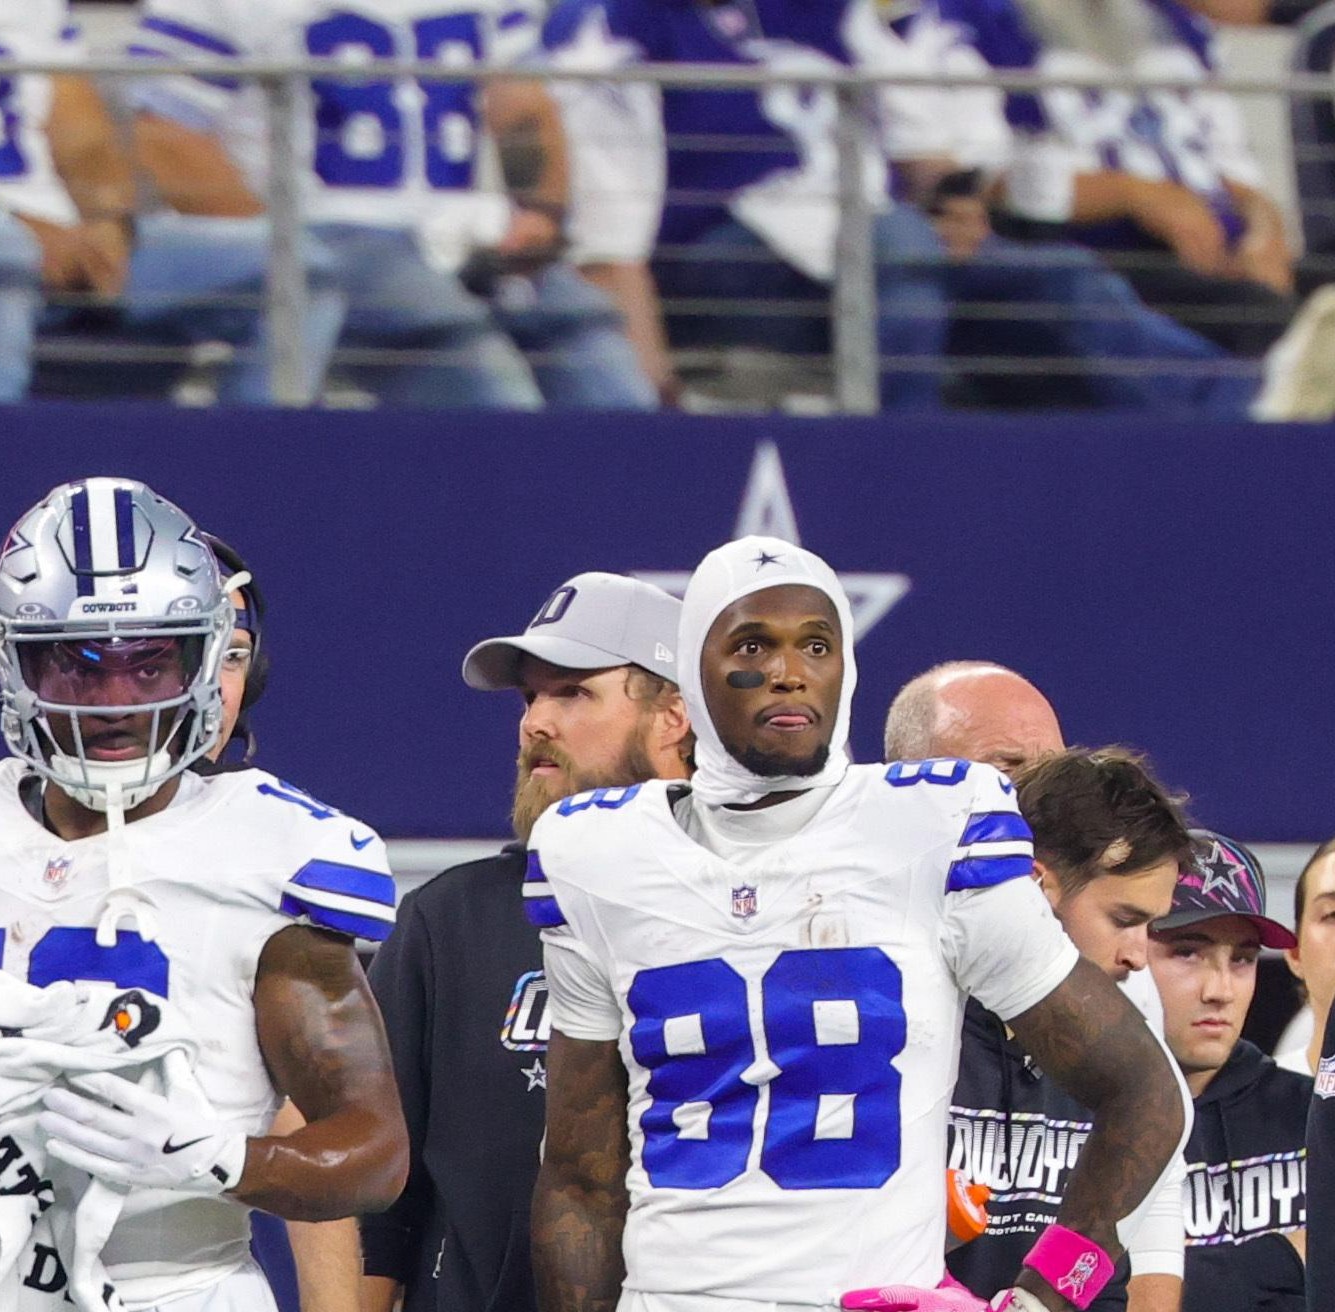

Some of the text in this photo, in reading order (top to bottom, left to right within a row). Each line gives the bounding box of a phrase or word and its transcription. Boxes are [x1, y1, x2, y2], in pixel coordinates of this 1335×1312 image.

[82, 602, 138, 613] COWBOYS
[735, 898, 756, 913] NFL
[626, 946, 907, 1190] 88
